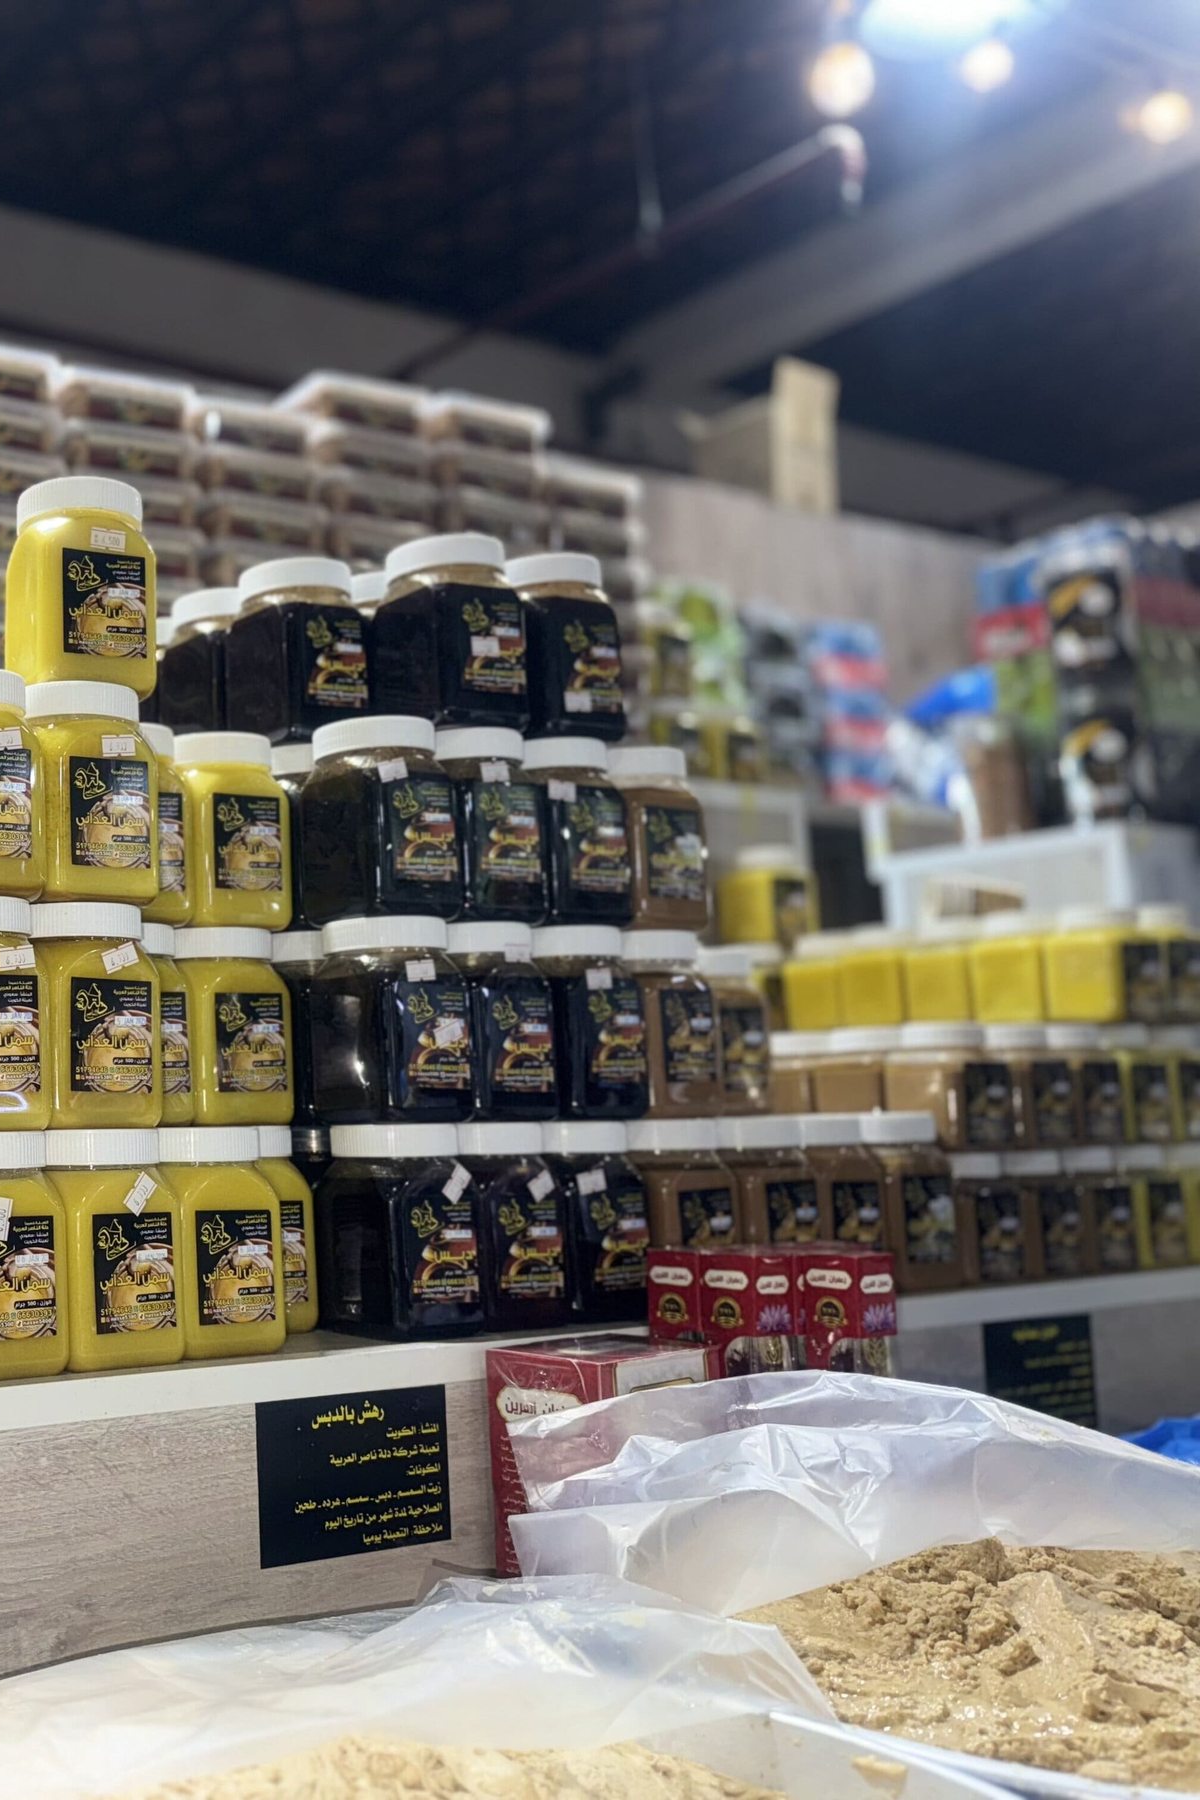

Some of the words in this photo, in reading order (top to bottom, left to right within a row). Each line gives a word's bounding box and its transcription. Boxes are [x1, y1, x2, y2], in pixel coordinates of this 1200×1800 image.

[0, 804, 27, 816] سمن
[5, 1035, 34, 1048] سمن
[120, 1038, 148, 1051] سمن
[21, 1277, 51, 1292] سمن
[142, 1272, 170, 1286] سمن
[312, 1405, 354, 1429] بالدبس
[358, 1400, 384, 1424] رهش
[386, 1426, 416, 1439] الكويت
[358, 1452, 377, 1464] ناصر
[378, 1449, 391, 1458] دلة
[392, 1445, 418, 1458] شركة
[330, 1453, 356, 1466] العربية
[398, 1485, 426, 1498] السمسم
[427, 1482, 441, 1494] زيت
[346, 1496, 369, 1506] سمسم
[375, 1491, 391, 1502] دبس
[295, 1500, 316, 1513] طحين
[408, 1503, 442, 1517] الصلاحية
[344, 1515, 363, 1528] تاريخ
[365, 1514, 376, 1524] من
[378, 1508, 393, 1522] شهر
[325, 1517, 342, 1530] اليوم
[363, 1534, 381, 1545] يوميا
